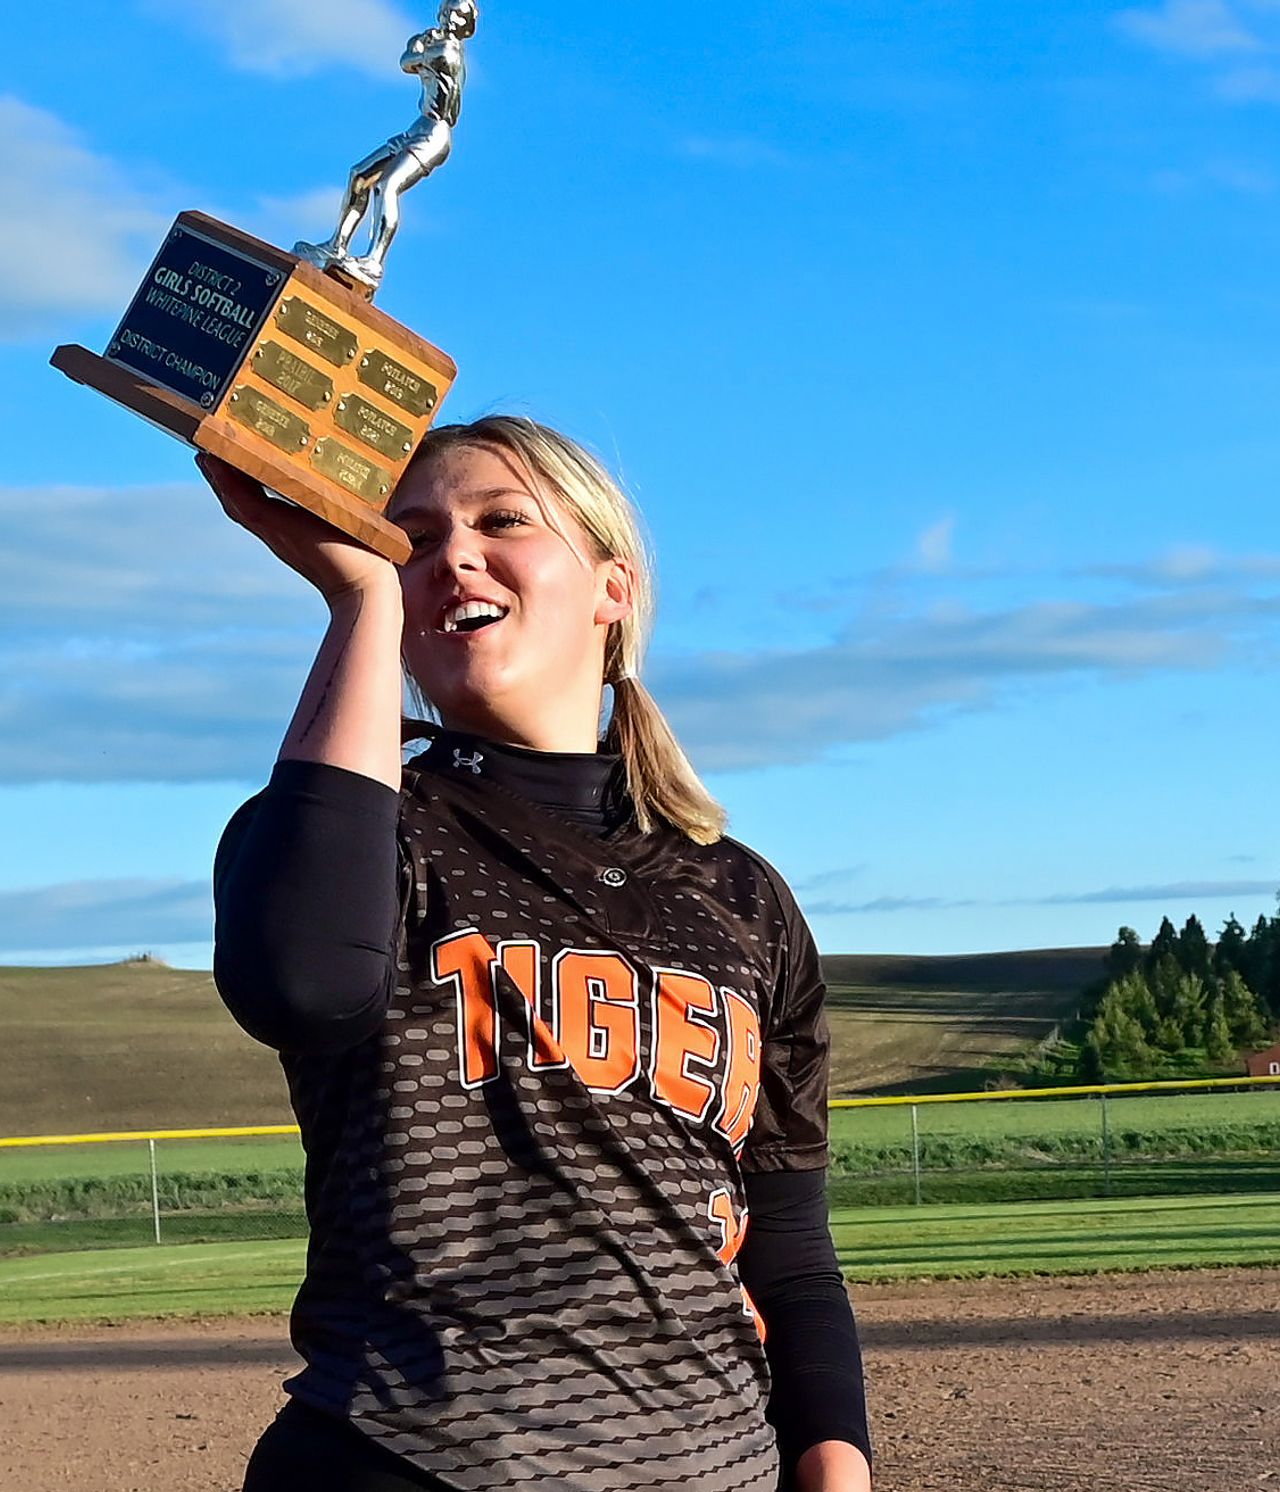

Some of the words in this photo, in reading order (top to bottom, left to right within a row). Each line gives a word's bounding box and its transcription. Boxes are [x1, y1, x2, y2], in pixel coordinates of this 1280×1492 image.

[154, 267, 192, 296] GIRLS
[190, 285, 255, 329] SOFTBALL
[188, 261, 235, 291] DISTRICT
[231, 281, 242, 296] 2
[145, 287, 205, 328] WHITEPINE
[201, 314, 247, 348] LEAGUE
[120, 328, 167, 361] DISTRICT
[165, 352, 221, 390] CHAMPION
[431, 927, 762, 1150] TIGER
